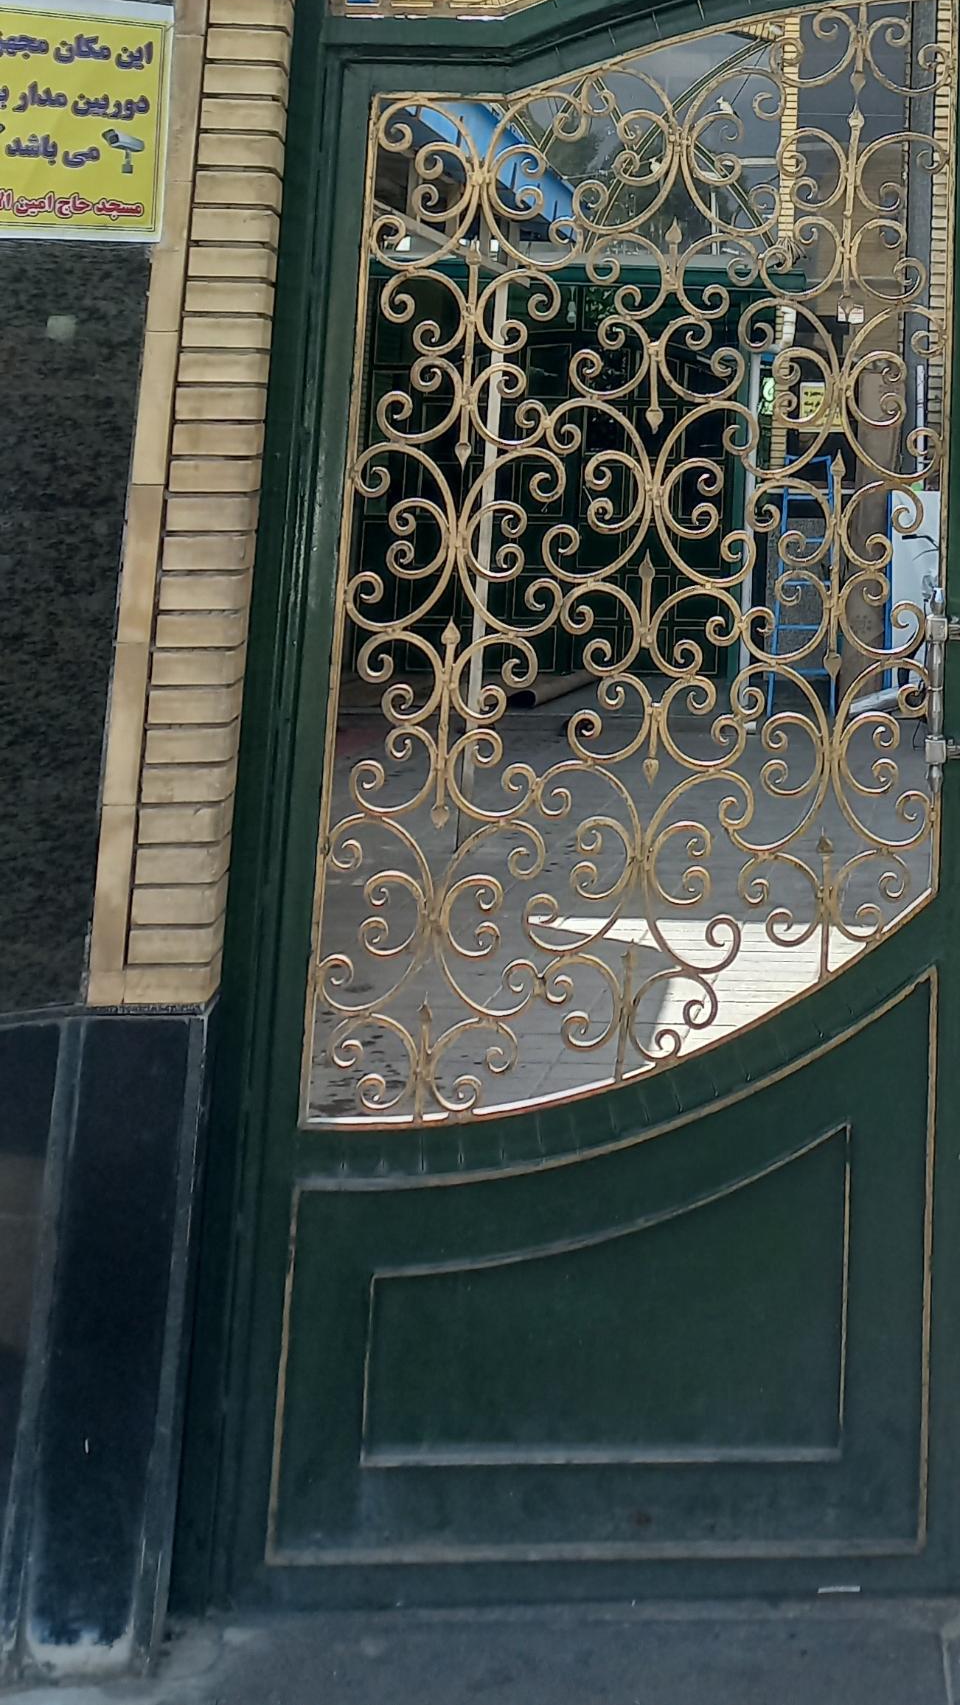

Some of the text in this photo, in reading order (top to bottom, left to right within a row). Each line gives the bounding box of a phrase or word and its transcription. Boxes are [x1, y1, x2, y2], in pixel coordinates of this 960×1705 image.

[53, 33, 111, 64] مکان
[115, 40, 153, 69] این
[12, 81, 68, 113] مدار
[71, 93, 150, 121] دوربین
[5, 134, 100, 168] می باشد
[13, 191, 55, 217] امین
[55, 192, 93, 219] حاج
[94, 198, 144, 221] مسجد
